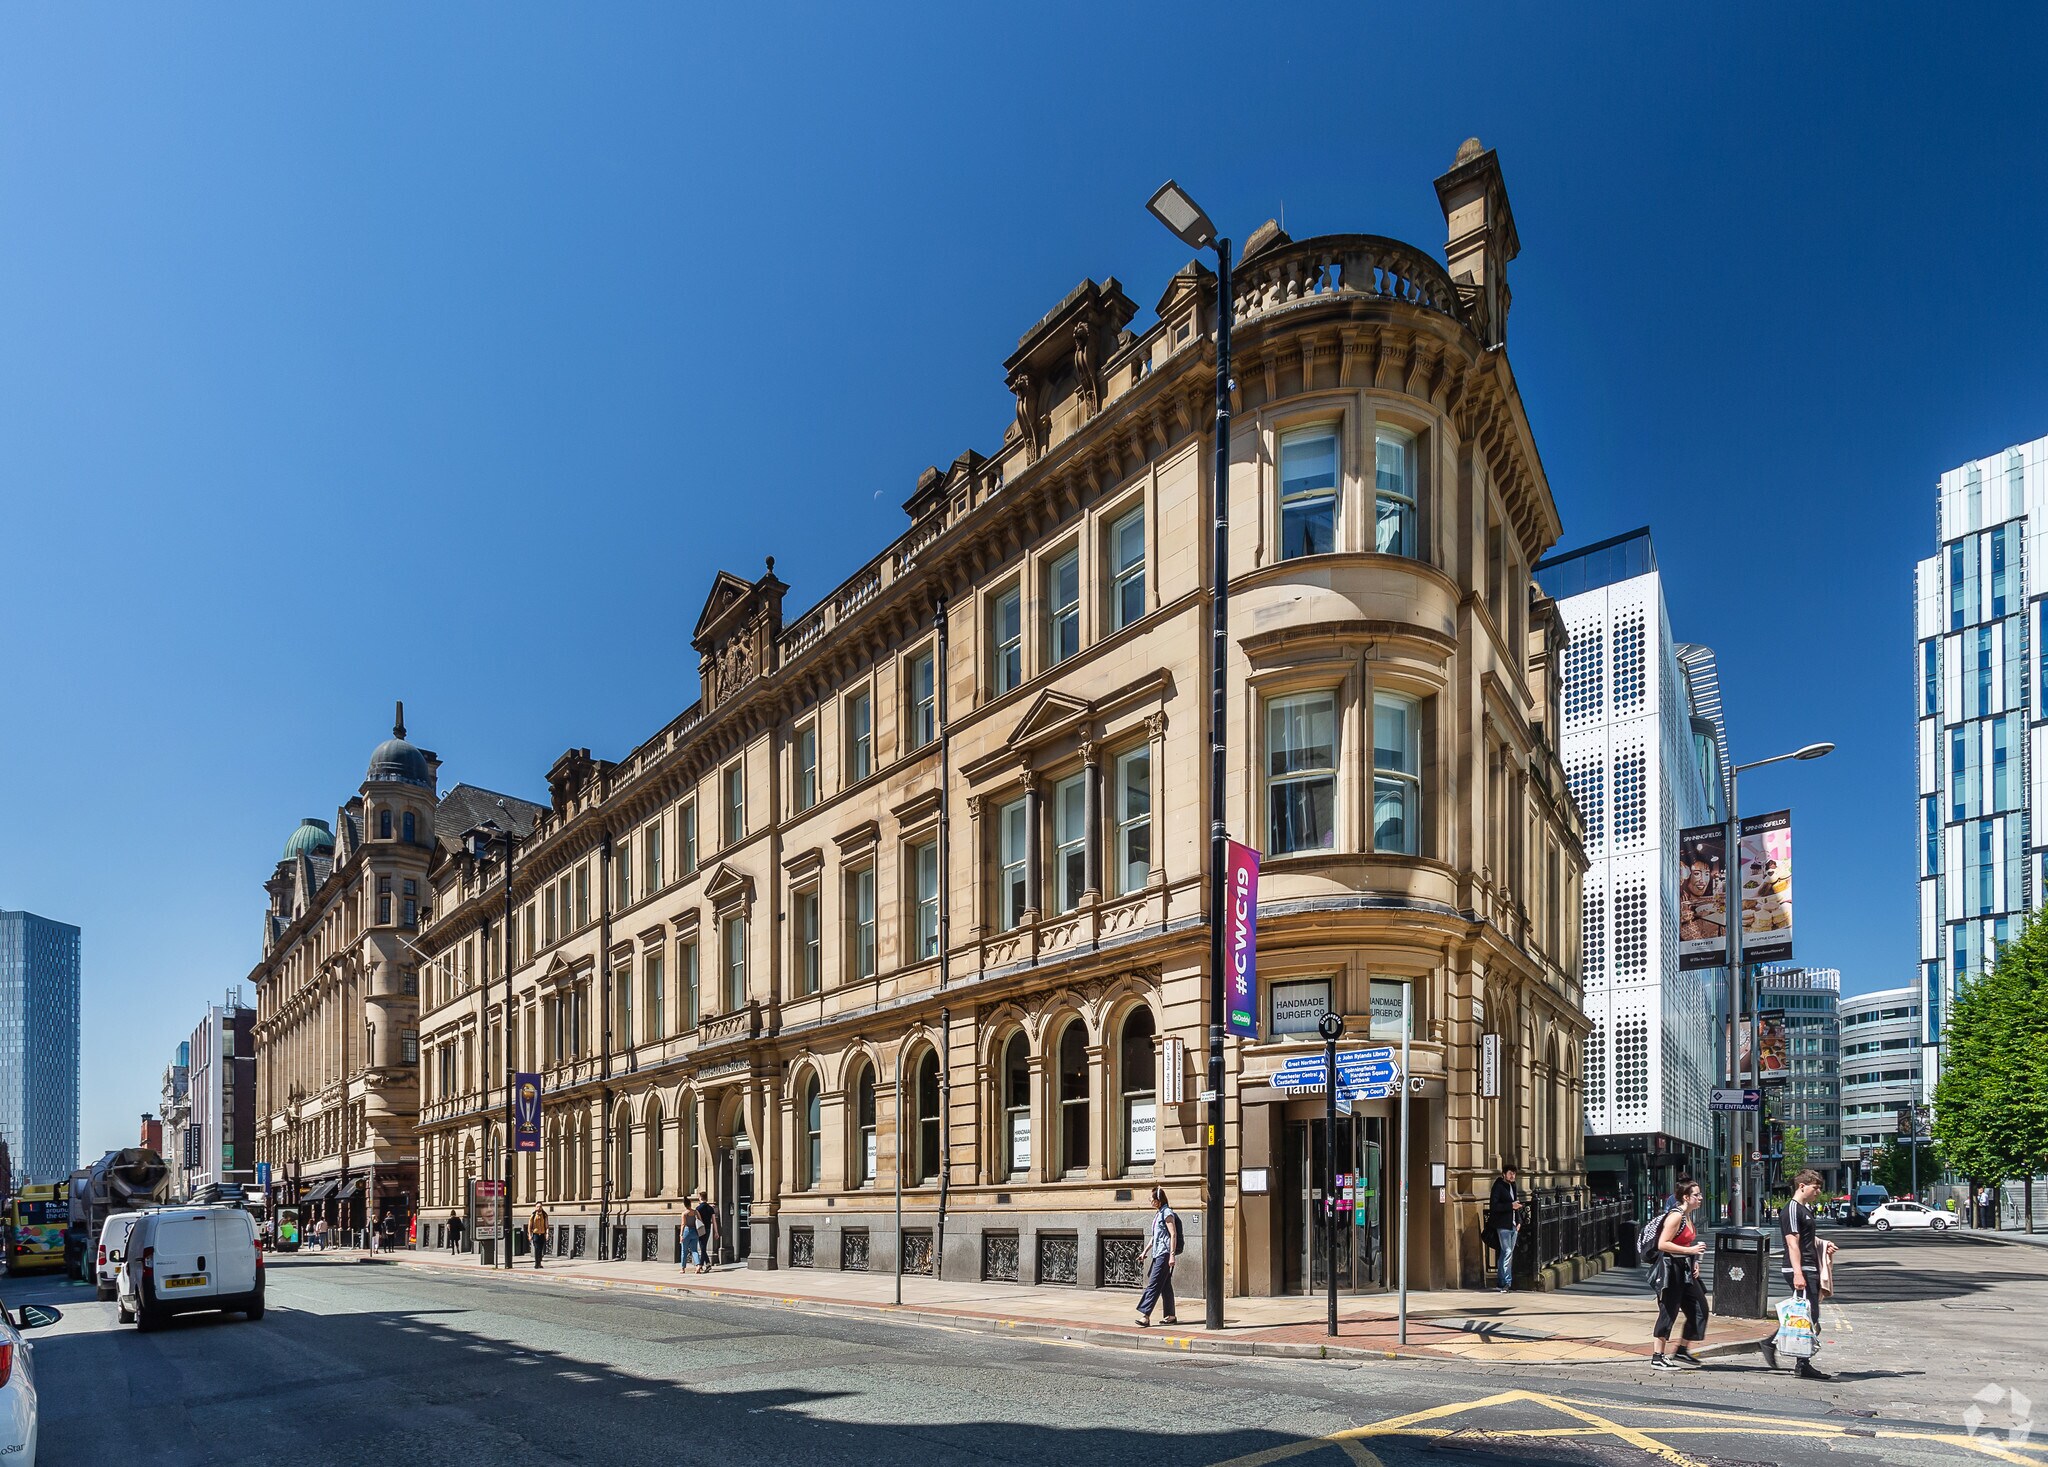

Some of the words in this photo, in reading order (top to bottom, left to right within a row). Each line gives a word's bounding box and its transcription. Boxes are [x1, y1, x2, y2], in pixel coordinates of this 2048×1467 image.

[1235, 867, 1249, 995] #CWC19
[1276, 998, 1324, 1009] HANDMADE
[1232, 1013, 1250, 1025] GoDaddy
[1277, 1010, 1311, 1020] BURGER
[1344, 1065, 1377, 1073] Spinningfields
[0, 1443, 26, 1455] oStar
